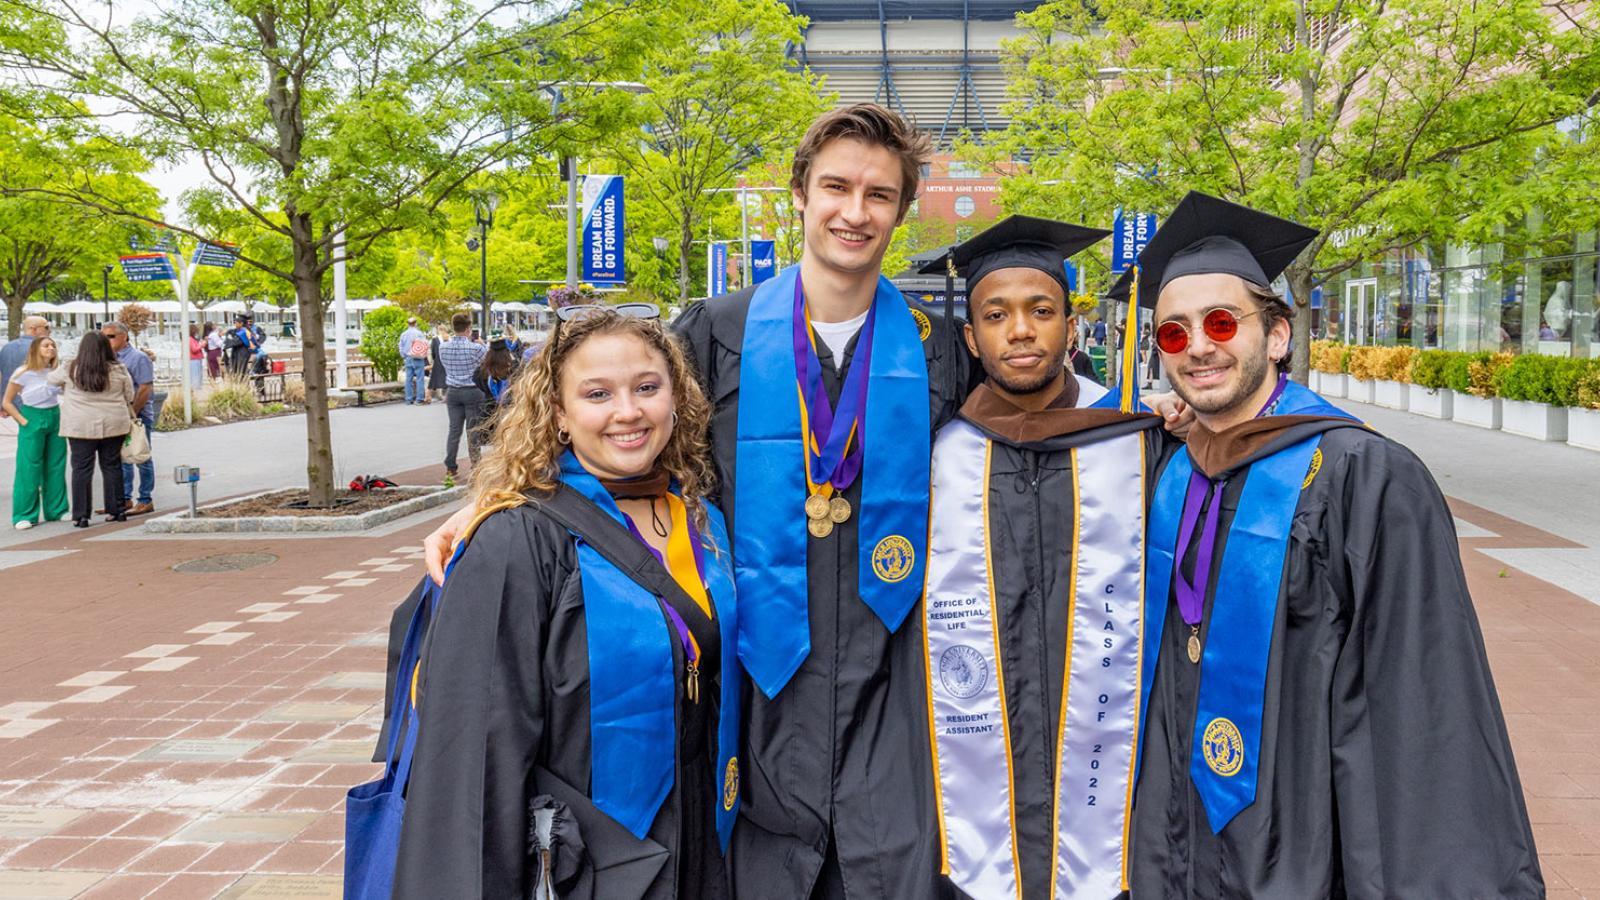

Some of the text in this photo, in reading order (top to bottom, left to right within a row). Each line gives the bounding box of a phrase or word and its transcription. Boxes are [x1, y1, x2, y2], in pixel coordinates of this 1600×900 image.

[604, 194, 616, 269] GO FORWARD.
[1123, 220, 1135, 259] DREAM
[592, 231, 603, 269] DREAM
[754, 258, 772, 267] PACE
[933, 598, 977, 609] OFFICE OF
[930, 608, 985, 620] RESIDENTIAL
[947, 622, 966, 631] LIFE
[1087, 583, 1115, 806] CLASS OF 2022
[946, 713, 989, 723] RESIDENT
[945, 724, 993, 735] ASSISTANT
